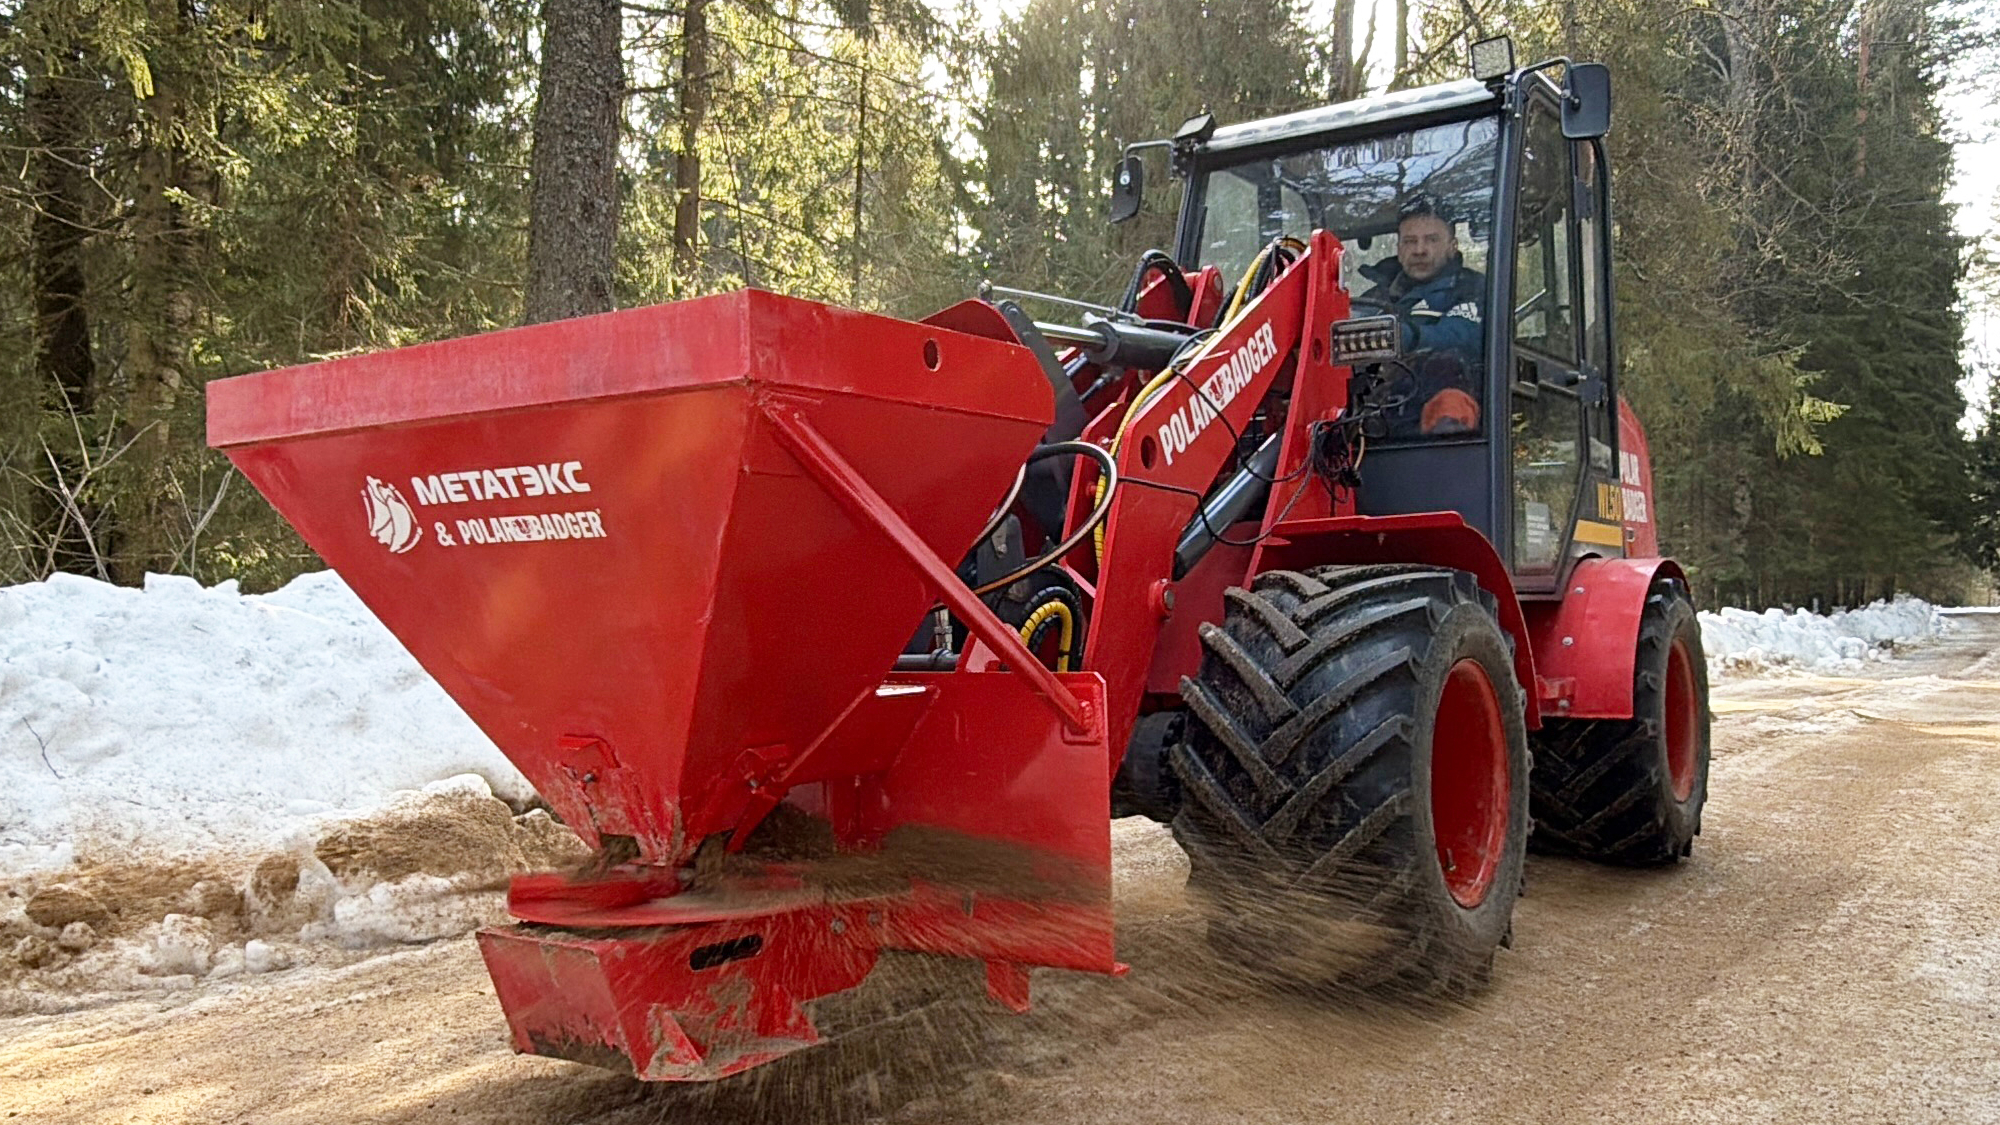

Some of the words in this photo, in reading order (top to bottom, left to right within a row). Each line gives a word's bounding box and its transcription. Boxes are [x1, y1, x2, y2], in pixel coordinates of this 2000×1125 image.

[1222, 322, 1278, 409] BADGER
[411, 461, 591, 505] МЕТАТЭКС
[435, 521, 456, 546] &
[457, 516, 512, 545] POLAR
[531, 511, 607, 541] BADGER
